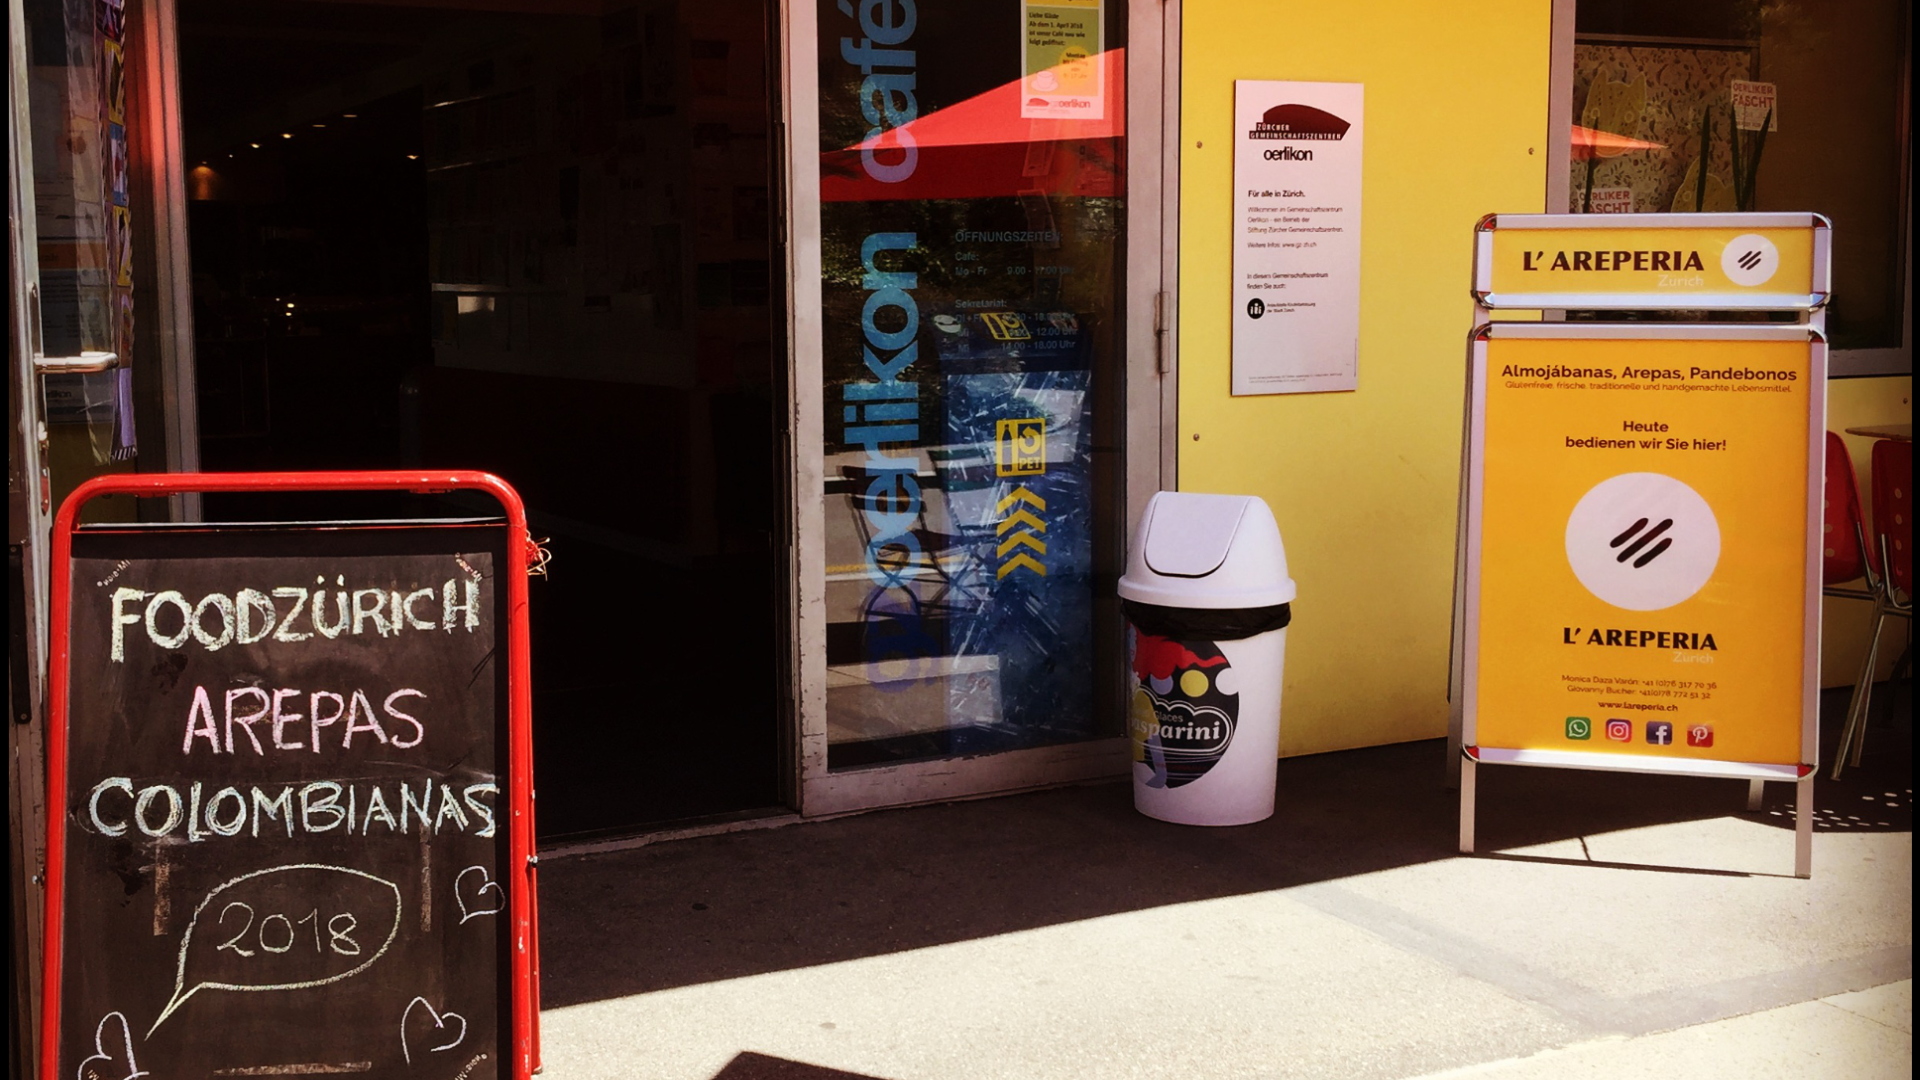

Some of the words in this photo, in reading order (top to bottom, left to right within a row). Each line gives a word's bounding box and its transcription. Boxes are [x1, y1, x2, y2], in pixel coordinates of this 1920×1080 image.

[1733, 82, 1773, 94] OERLIKER
[1059, 98, 1091, 108] oerlikon
[1732, 94, 1774, 108] FASCHT
[1257, 123, 1290, 131] ZÜRCHER
[1263, 146, 1313, 161] oerlikon
[1282, 190, 1306, 198] Zürich.
[1579, 190, 1630, 201] ORLIKER
[1582, 201, 1631, 213] ASCHT
[1550, 251, 1705, 271] AREPERIA
[955, 267, 969, 276] Mo
[977, 266, 988, 275] Fr
[1007, 266, 1026, 276] 9.00
[955, 299, 1007, 308] Sekretariat:
[1037, 328, 1059, 336] 12.00
[1035, 341, 1057, 349] 18.00
[1059, 341, 1075, 349] Uhr
[1502, 365, 1617, 380] Almojábanas,
[1622, 366, 1685, 382] Arepas,
[1690, 367, 1798, 381] Pandebonos
[1590, 382, 1641, 390] traditionelle
[1643, 383, 1660, 391] und
[1662, 383, 1730, 393] handgemachte
[843, 232, 921, 588] oerlikon
[1623, 420, 1669, 432] Heute
[1566, 436, 1636, 449] bedienen
[1639, 438, 1662, 449] wir
[1666, 438, 1689, 450] Sie
[1693, 438, 1726, 451] hier!
[1019, 457, 1041, 469] PET
[110, 574, 480, 663] FOODZÜRICH
[1586, 628, 1718, 651] AREPERIA
[1561, 674, 1591, 683] Monica
[1593, 676, 1613, 685] Daza
[1678, 681, 1692, 689] 317
[1706, 681, 1717, 690] 36
[1567, 685, 1604, 695] Giovanny
[1673, 690, 1688, 698] 772
[1701, 692, 1711, 700] 32
[182, 686, 427, 756] AREPAS
[1153, 710, 1184, 723] Glaces
[88, 776, 500, 842] COLOMBIANAS
[216, 902, 361, 957] 2018
